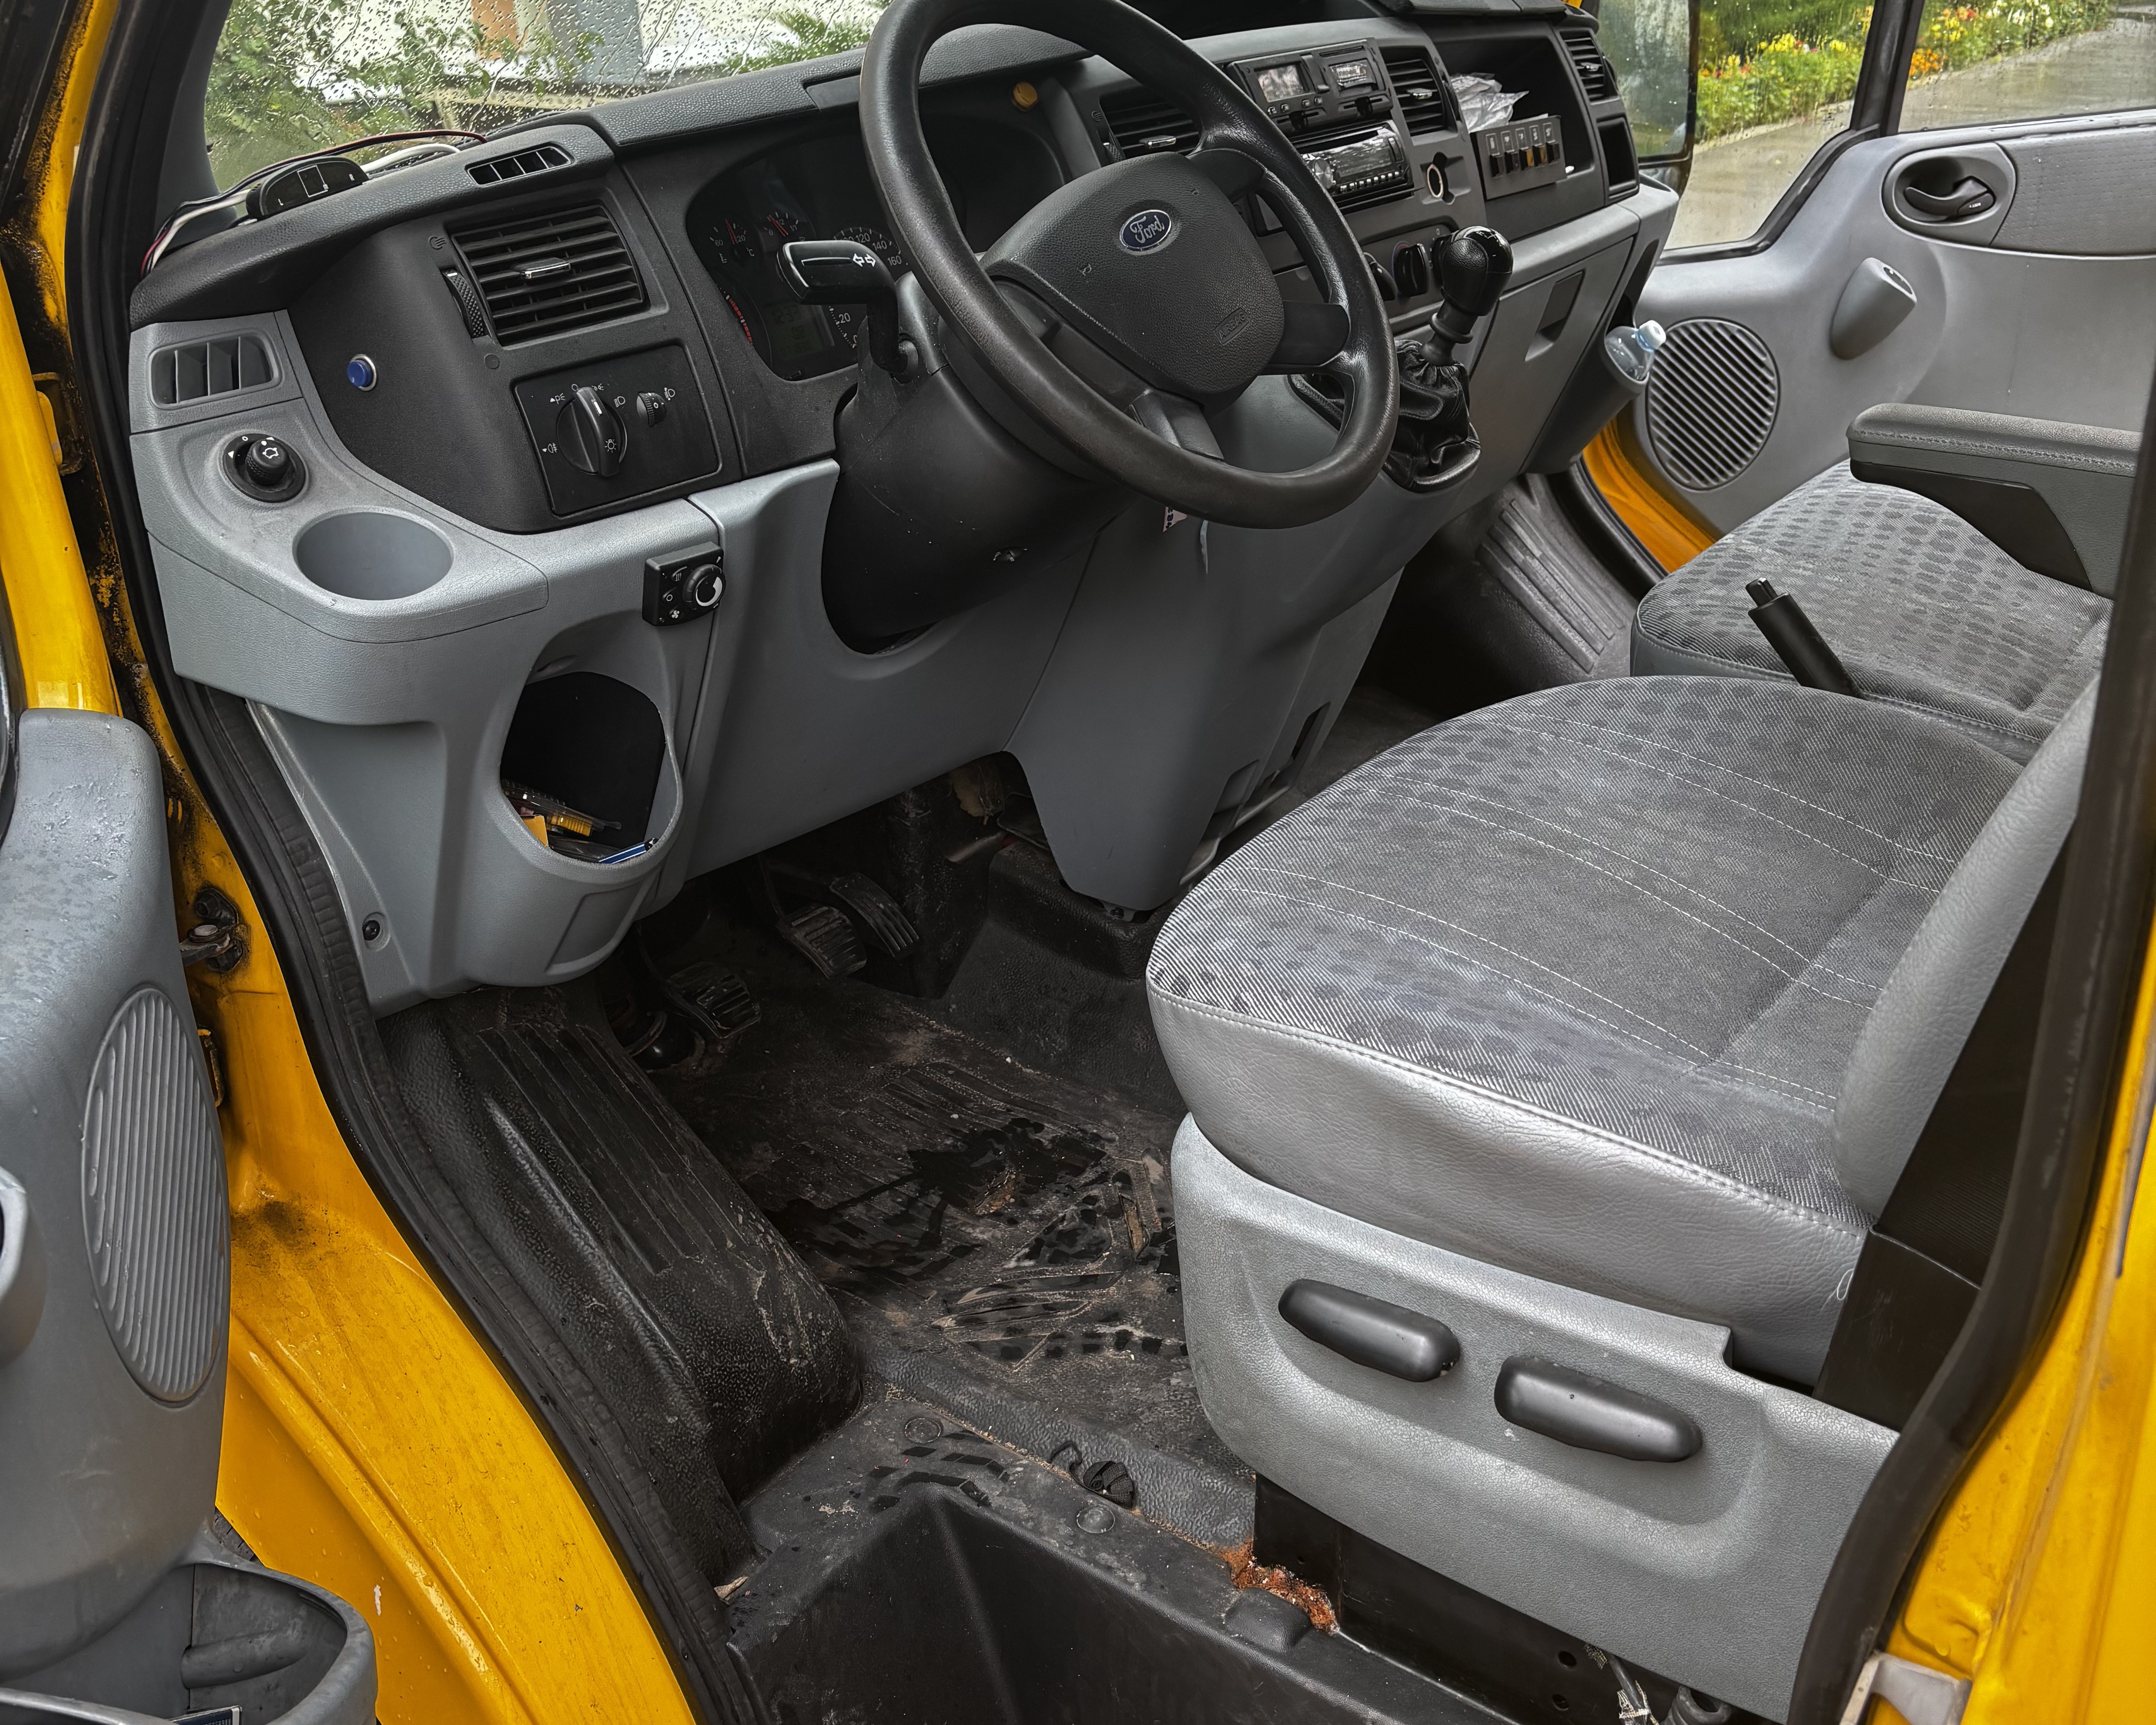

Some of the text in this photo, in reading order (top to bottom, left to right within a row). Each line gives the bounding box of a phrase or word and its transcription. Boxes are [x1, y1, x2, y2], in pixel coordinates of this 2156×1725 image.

[1129, 215, 1165, 244] Ford
[856, 233, 870, 243] 120
[872, 240, 887, 252] 140
[887, 255, 902, 266] 160
[838, 313, 851, 324] 20
[1218, 312, 1246, 340] AIRBAG
